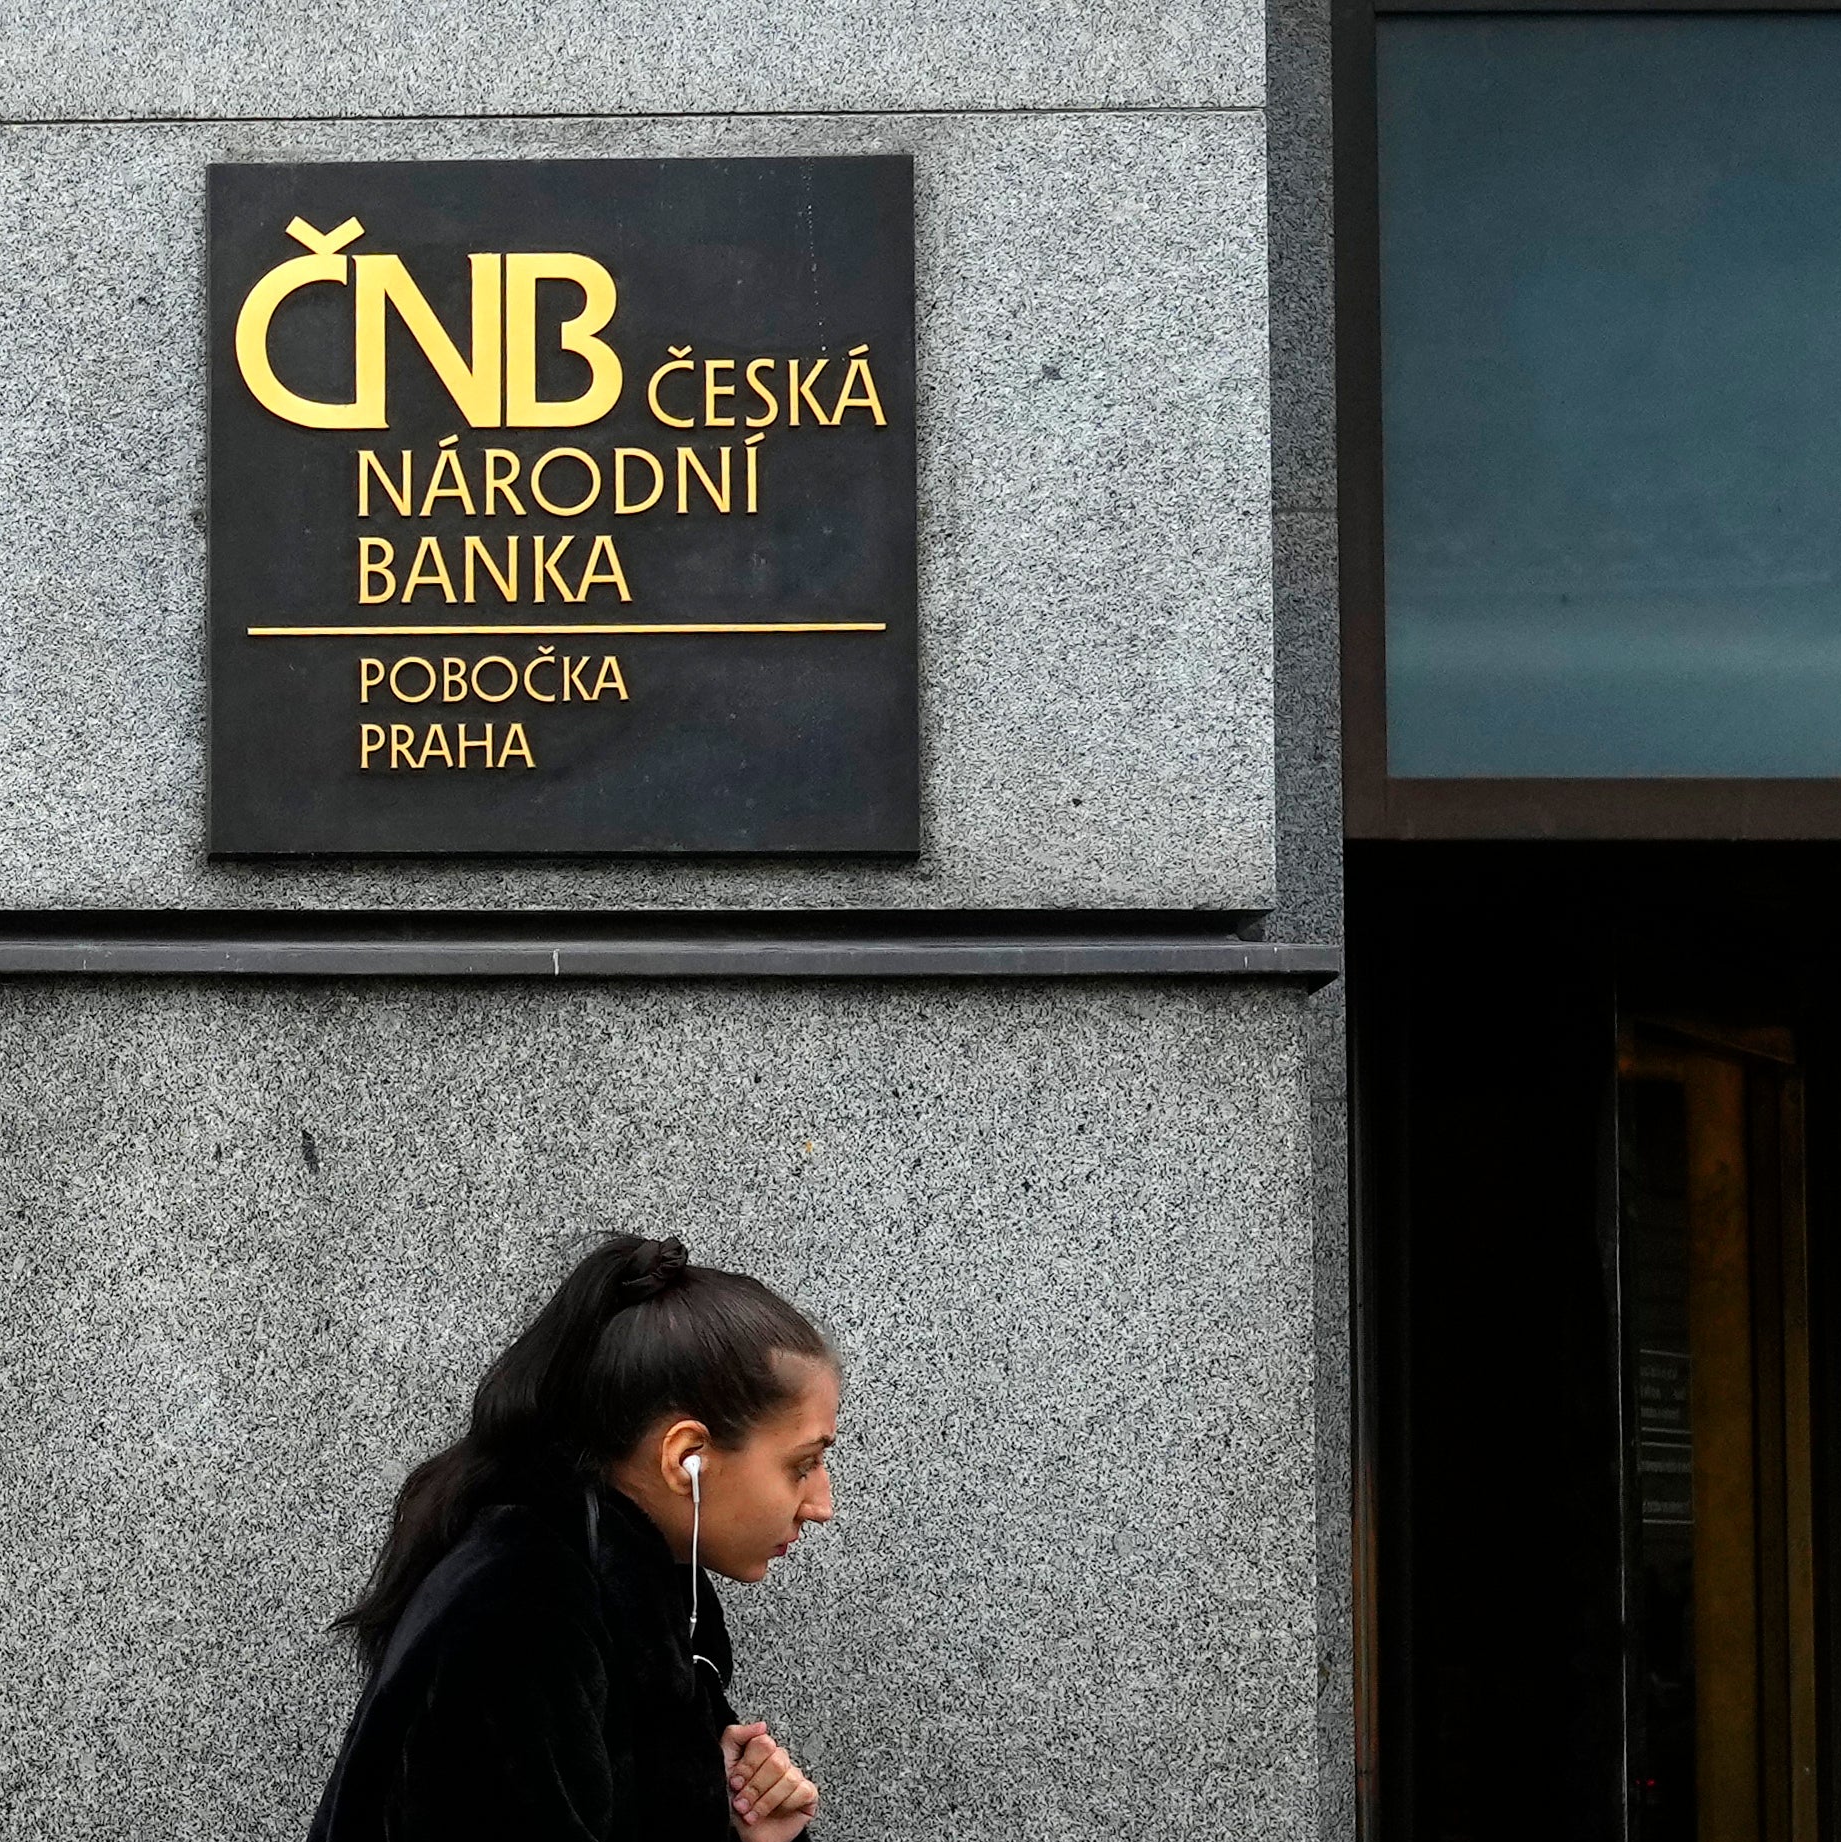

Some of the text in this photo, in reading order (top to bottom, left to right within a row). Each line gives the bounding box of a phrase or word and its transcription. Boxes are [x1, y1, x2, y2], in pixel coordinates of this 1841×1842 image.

[235, 216, 887, 429] ČNB ČESKÁ
[358, 433, 766, 517] NÁRODNÍ
[358, 535, 632, 604] BANKA
[359, 645, 629, 703] POBOČKA
[359, 723, 536, 770] PRAHA
